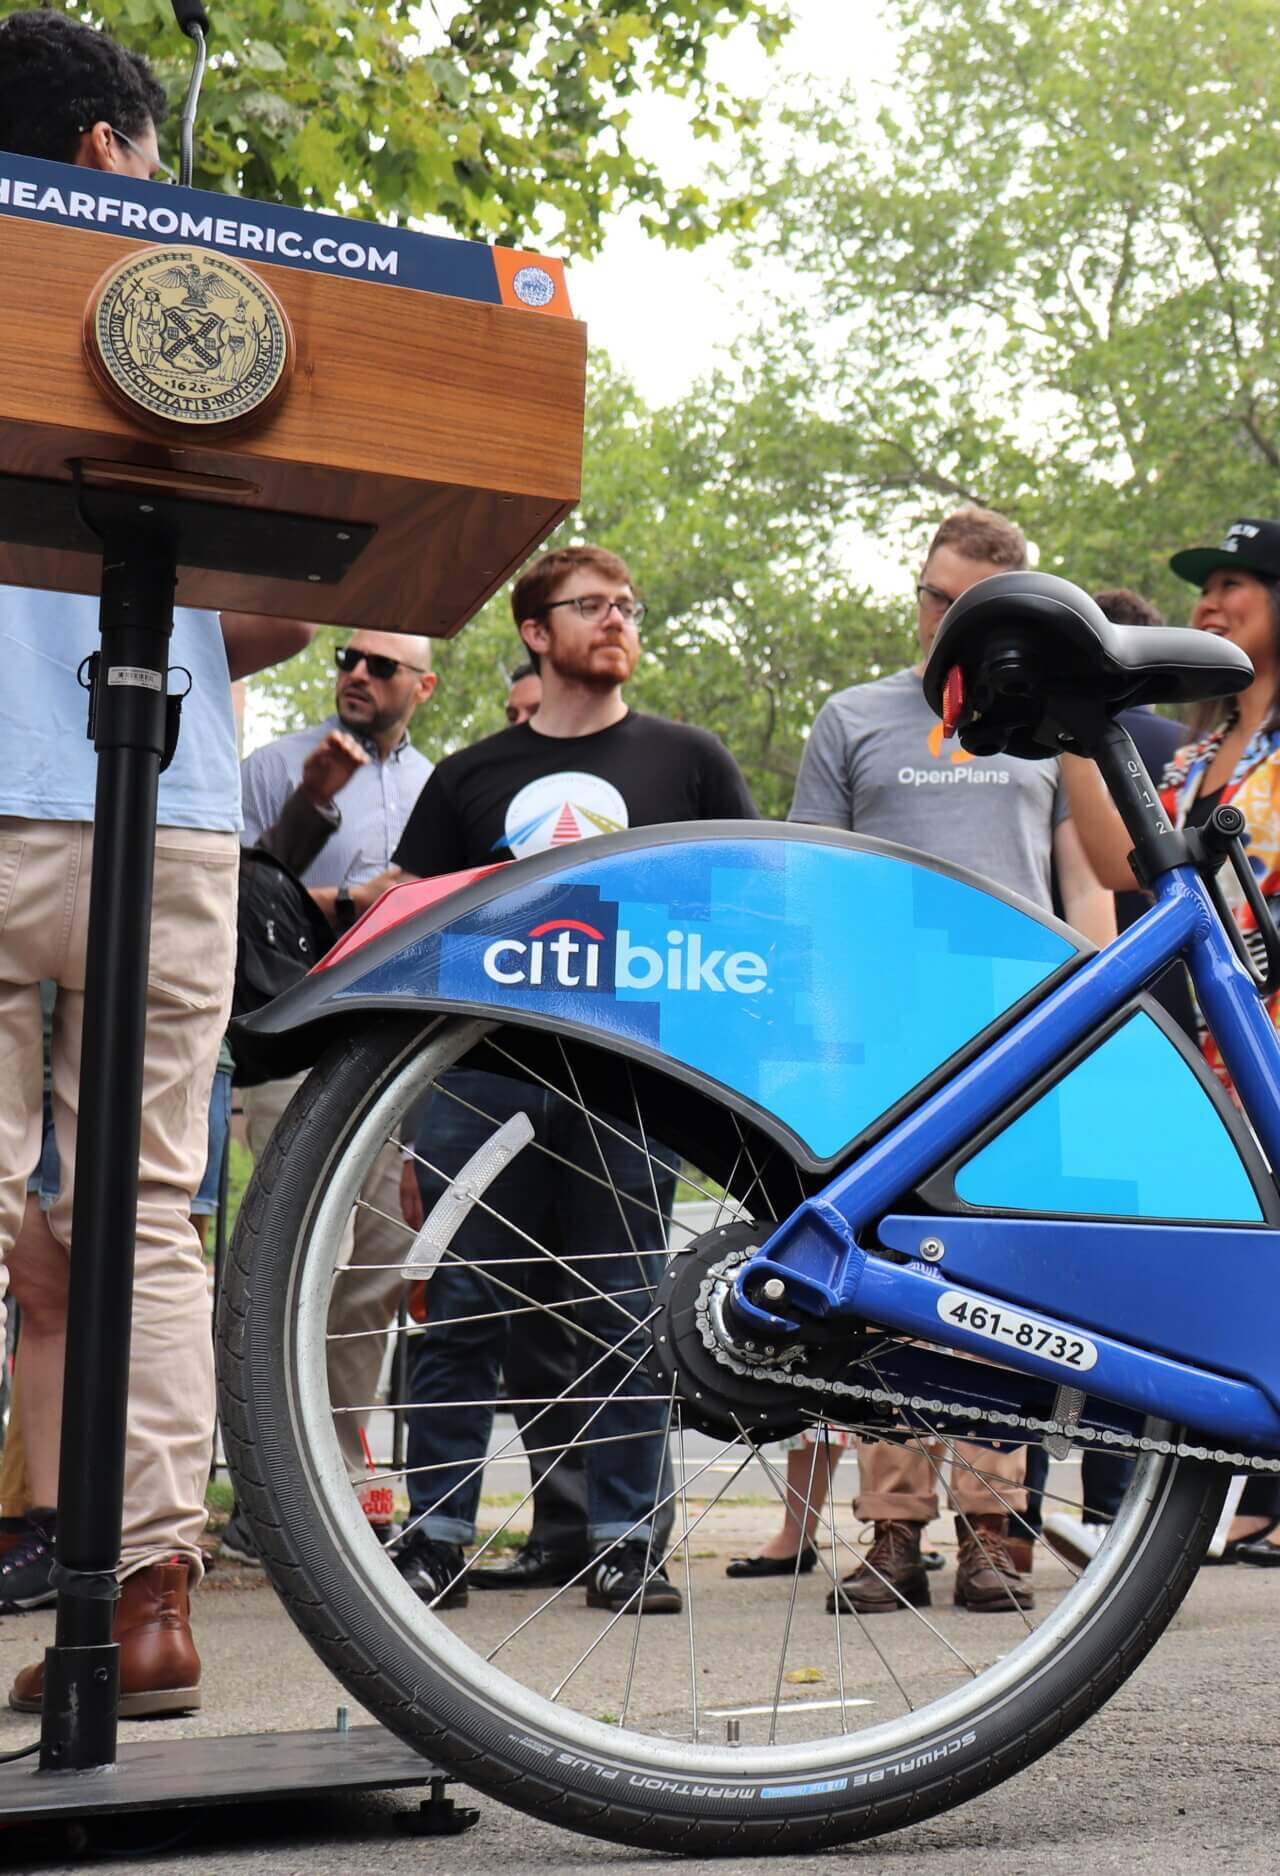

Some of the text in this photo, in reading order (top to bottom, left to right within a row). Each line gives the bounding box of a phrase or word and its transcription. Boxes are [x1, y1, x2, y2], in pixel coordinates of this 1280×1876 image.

[171, 379, 208, 394] 1625
[897, 766, 1010, 787] OpenPlans
[483, 920, 769, 994] citi bike
[948, 1301, 1085, 1366] 461-8732
[555, 1752, 620, 1781] PLUS
[852, 1729, 977, 1788] SCHWALBE
[629, 1775, 756, 1800] MARATHON
